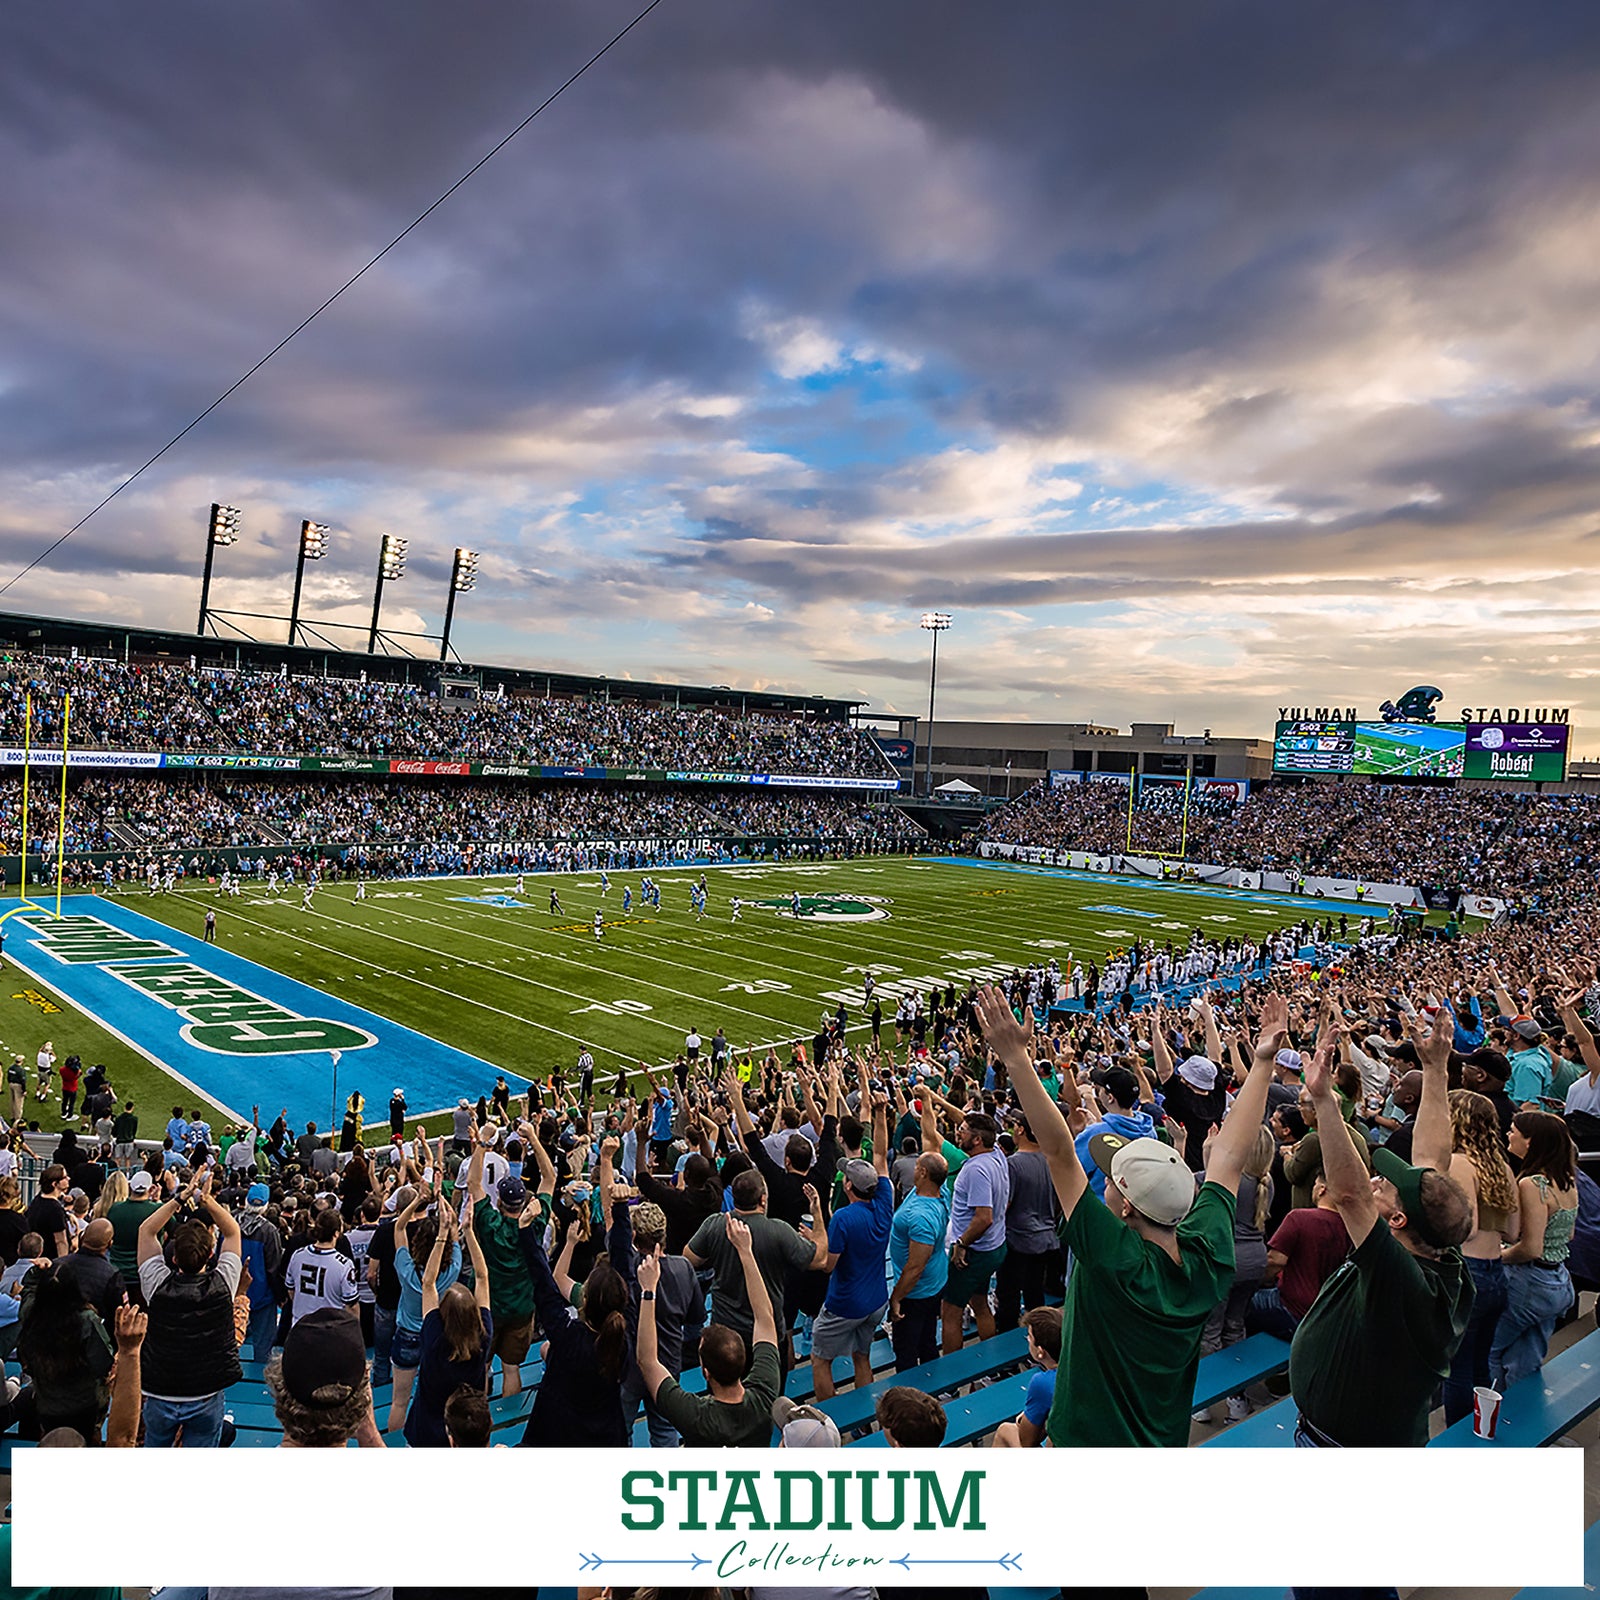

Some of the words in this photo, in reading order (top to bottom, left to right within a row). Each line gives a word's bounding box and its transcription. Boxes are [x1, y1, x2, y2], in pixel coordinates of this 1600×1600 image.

[1278, 708, 1357, 721] YULMAN
[1461, 708, 1570, 723] STADIUM
[1300, 723, 1321, 731] 5:02
[70, 754, 156, 765] kentwoodsprings.com
[97, 962, 379, 1056] GREEN
[486, 1163, 495, 1184] 1
[300, 1263, 327, 1297] 21
